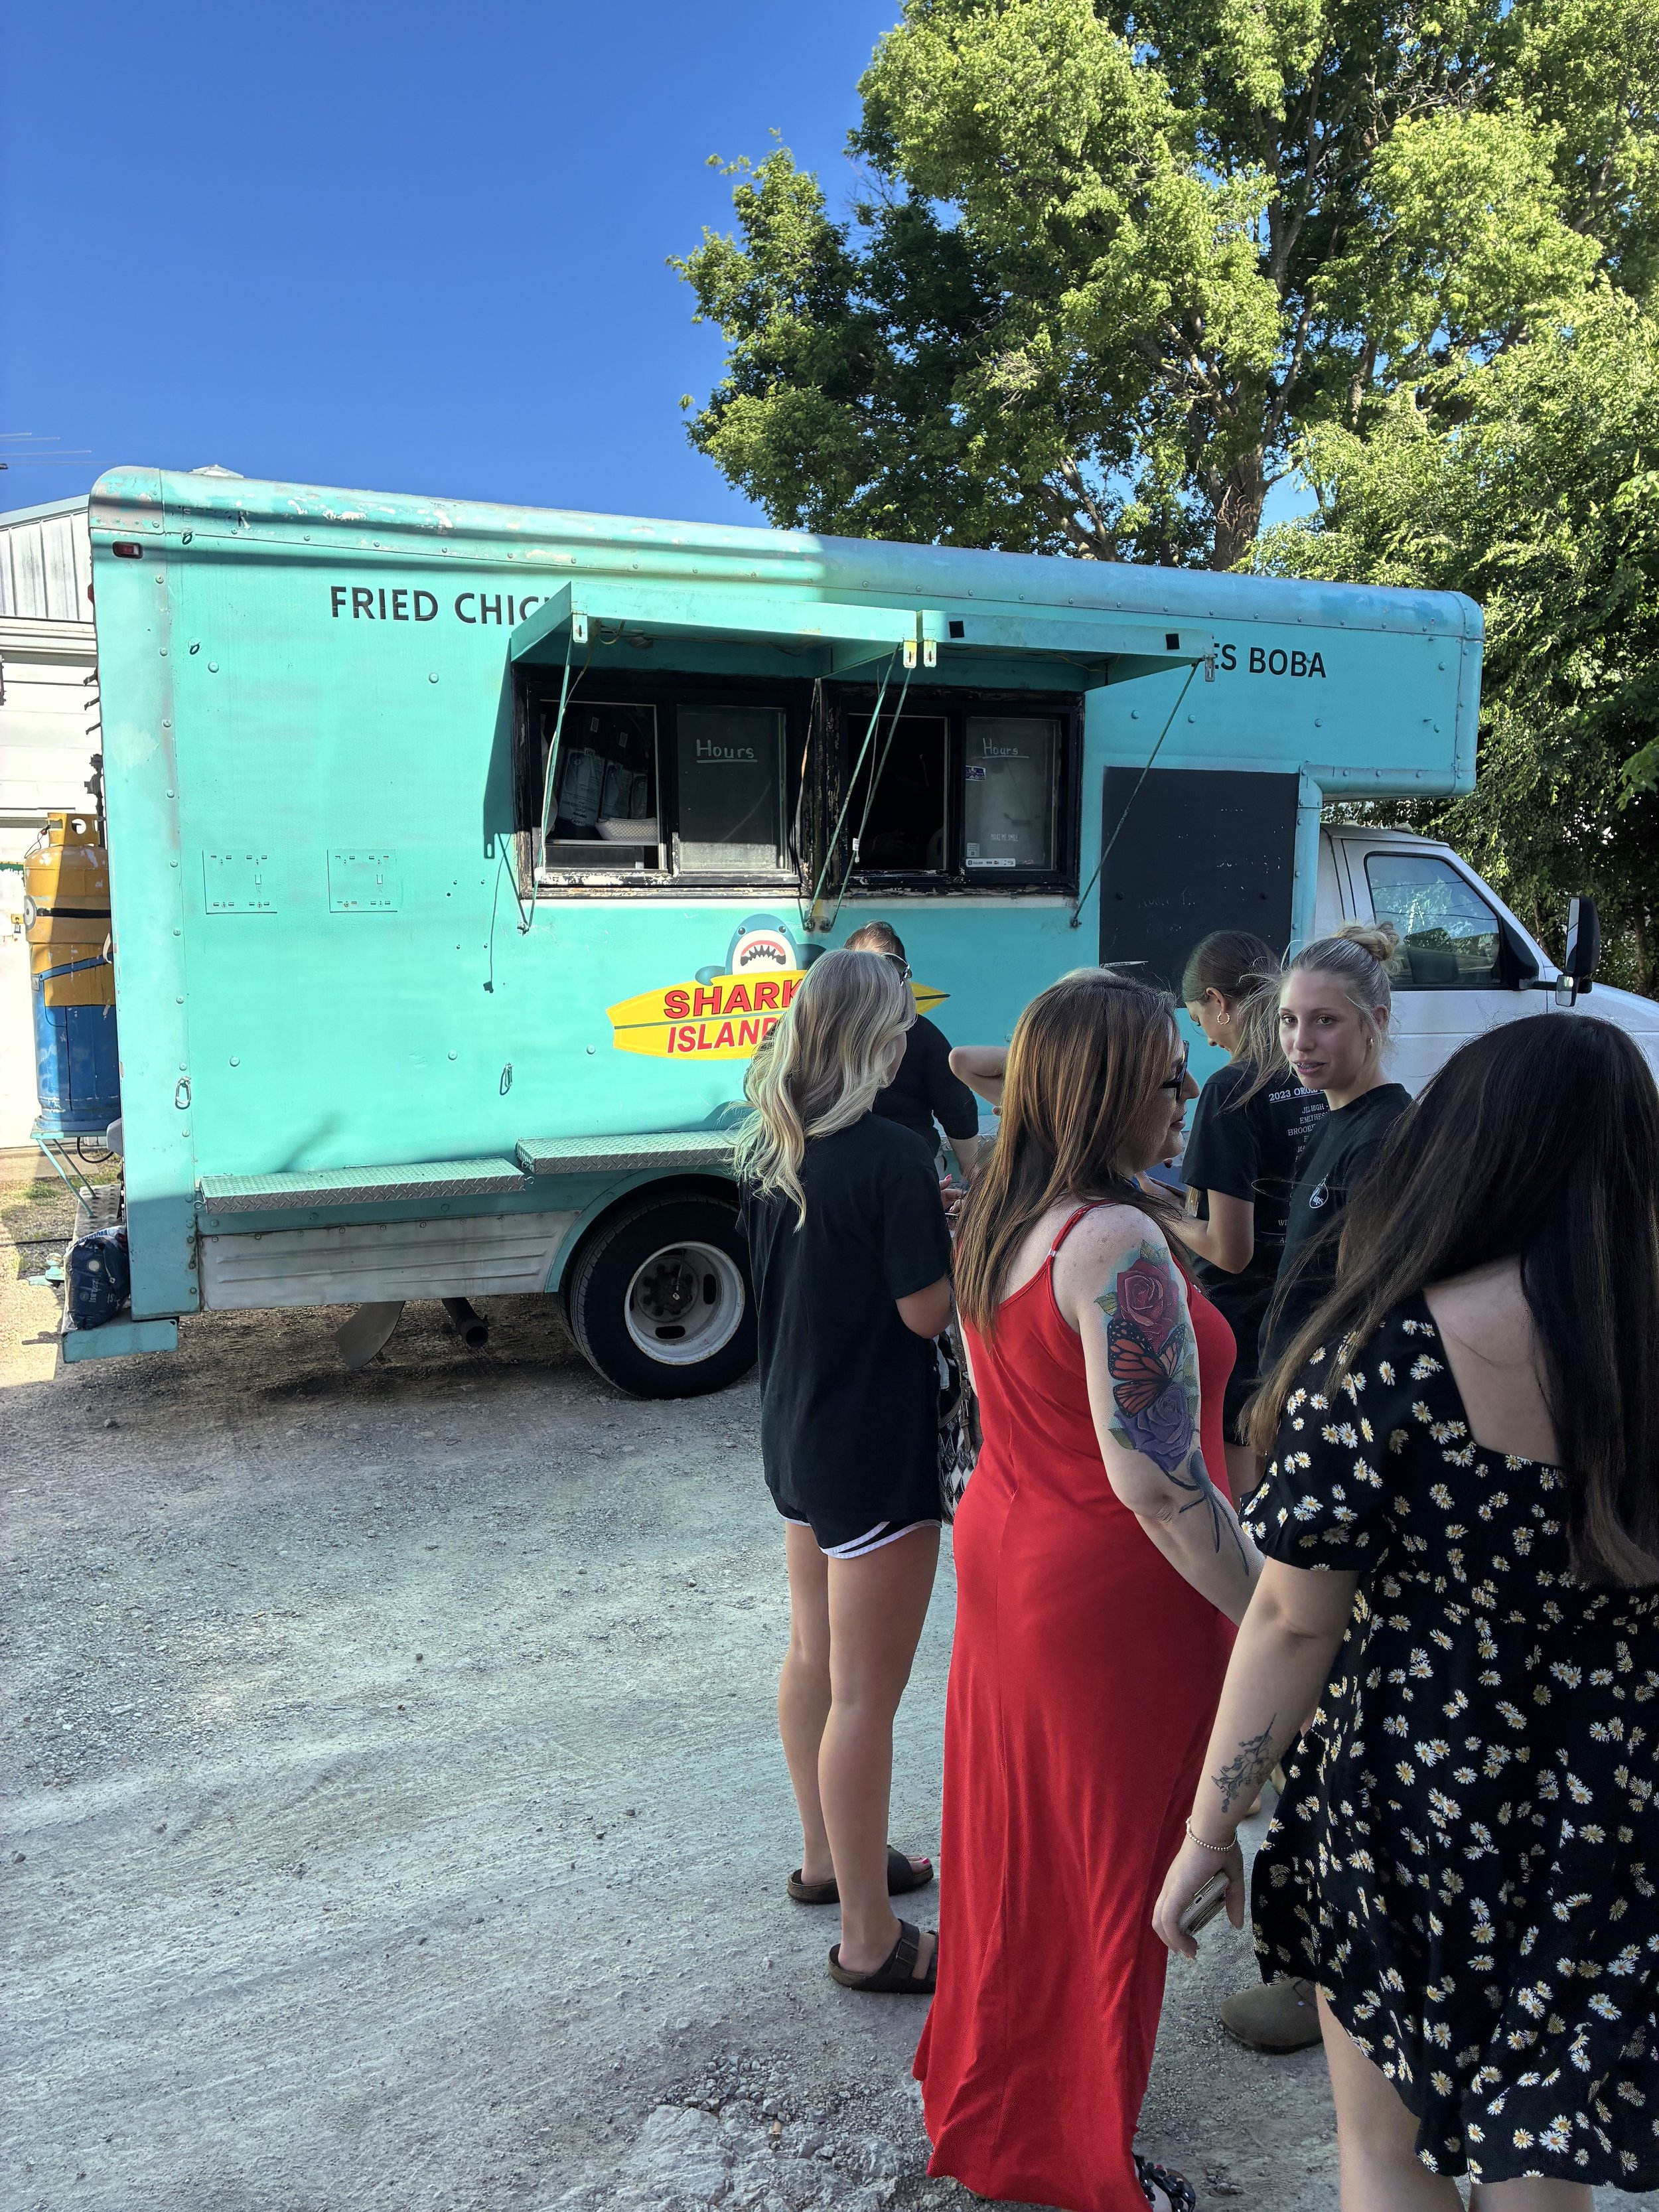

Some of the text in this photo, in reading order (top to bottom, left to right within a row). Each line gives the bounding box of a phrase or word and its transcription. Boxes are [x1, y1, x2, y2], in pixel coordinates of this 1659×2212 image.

[330, 585, 549, 626] FRIED CHIC
[1249, 646, 1327, 678] BOBA
[696, 739, 755, 759] Hours
[982, 737, 1019, 755] Hours
[663, 978, 803, 1019] SHARK
[1268, 1089, 1291, 1102] 2023
